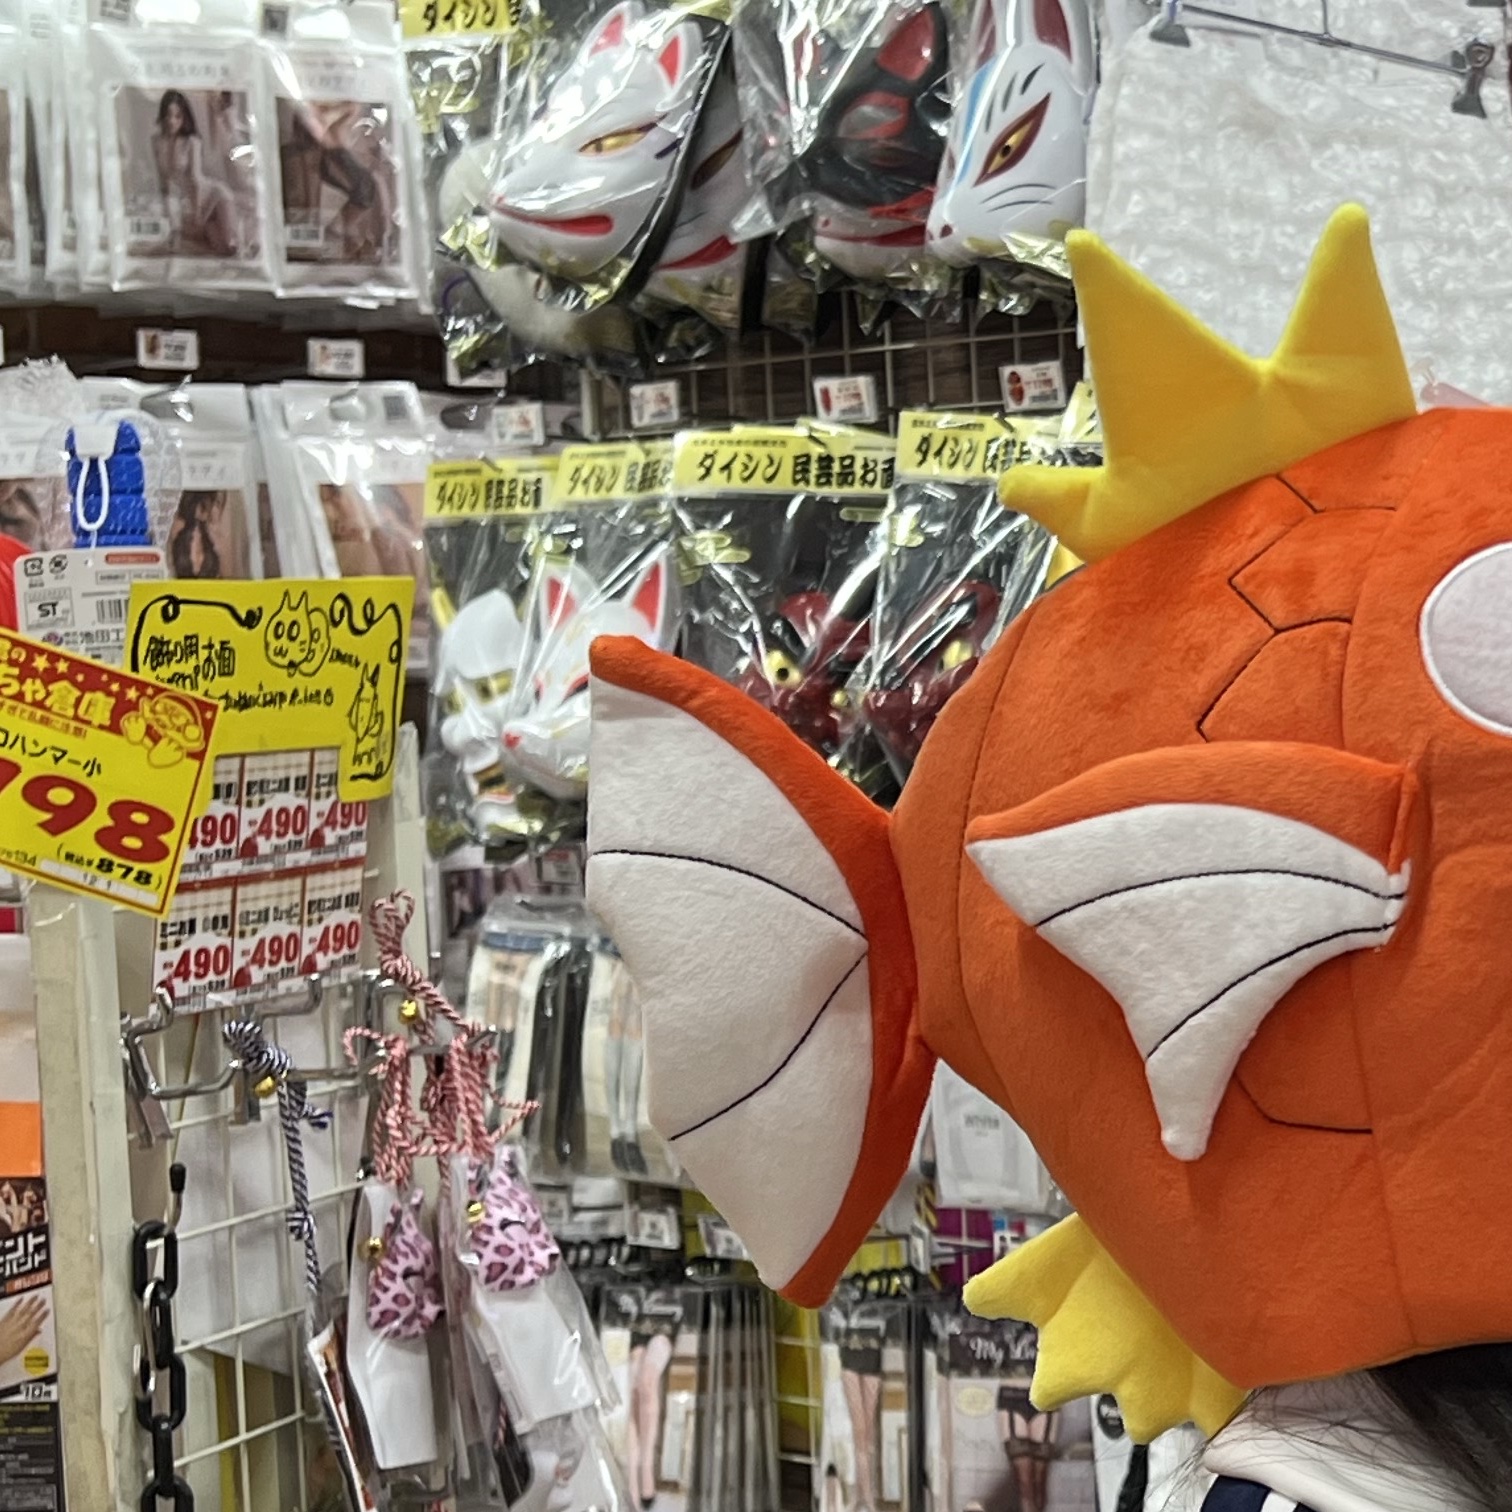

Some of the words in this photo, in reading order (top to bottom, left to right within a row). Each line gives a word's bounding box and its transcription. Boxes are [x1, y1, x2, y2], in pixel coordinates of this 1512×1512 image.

[696, 451, 782, 484] ダイシン
[37, 601, 59, 618] ST
[257, 804, 308, 841] 490
[323, 800, 367, 832] 490
[249, 931, 300, 969] 490
[315, 919, 361, 956] 490
[173, 944, 230, 983] 490
